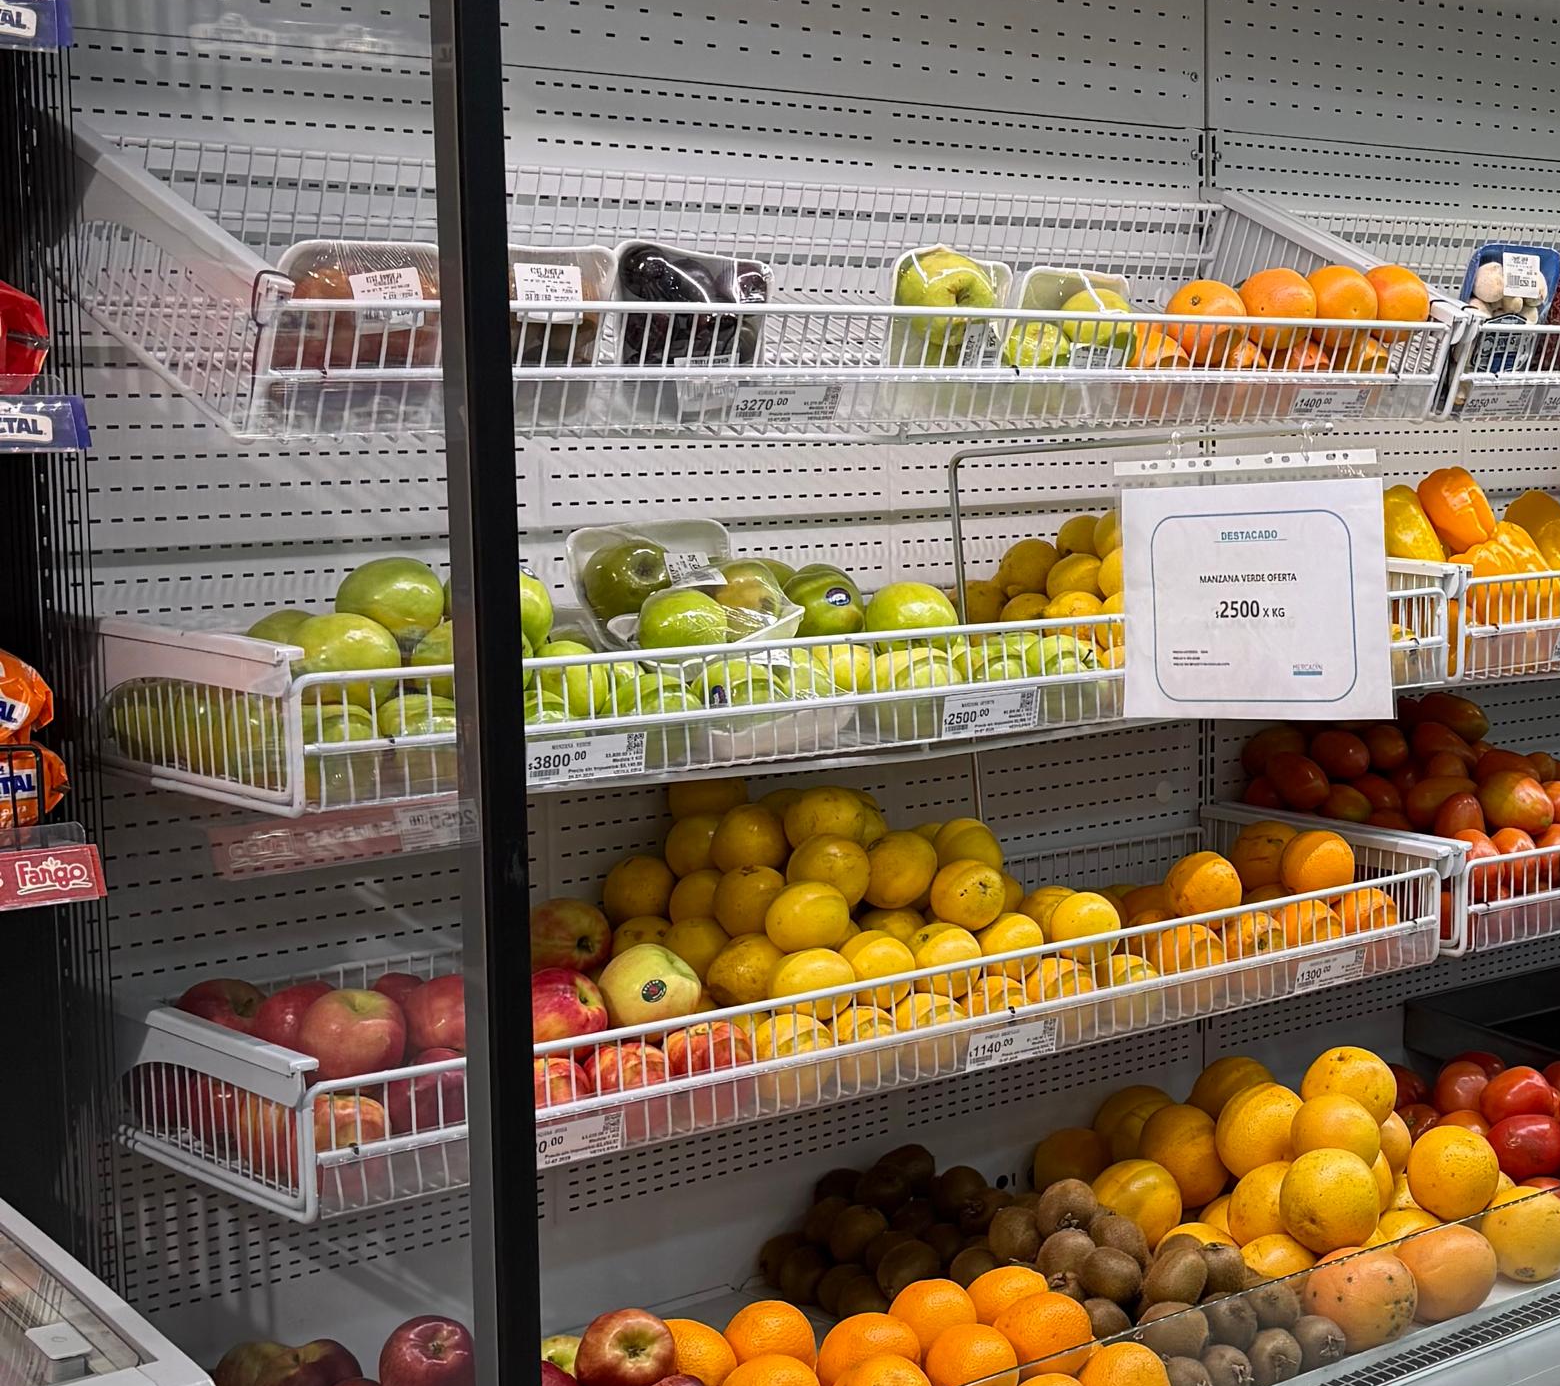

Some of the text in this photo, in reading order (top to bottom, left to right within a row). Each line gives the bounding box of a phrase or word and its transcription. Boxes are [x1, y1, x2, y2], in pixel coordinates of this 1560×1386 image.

[0, 417, 43, 435] TAL
[1221, 530, 1278, 541] DESTACADO
[1200, 572, 1297, 584] MANZANA VERDE OFERTA
[1215, 600, 1260, 619] $2500
[1272, 607, 1285, 618] KG
[17, 861, 88, 891] Fango
